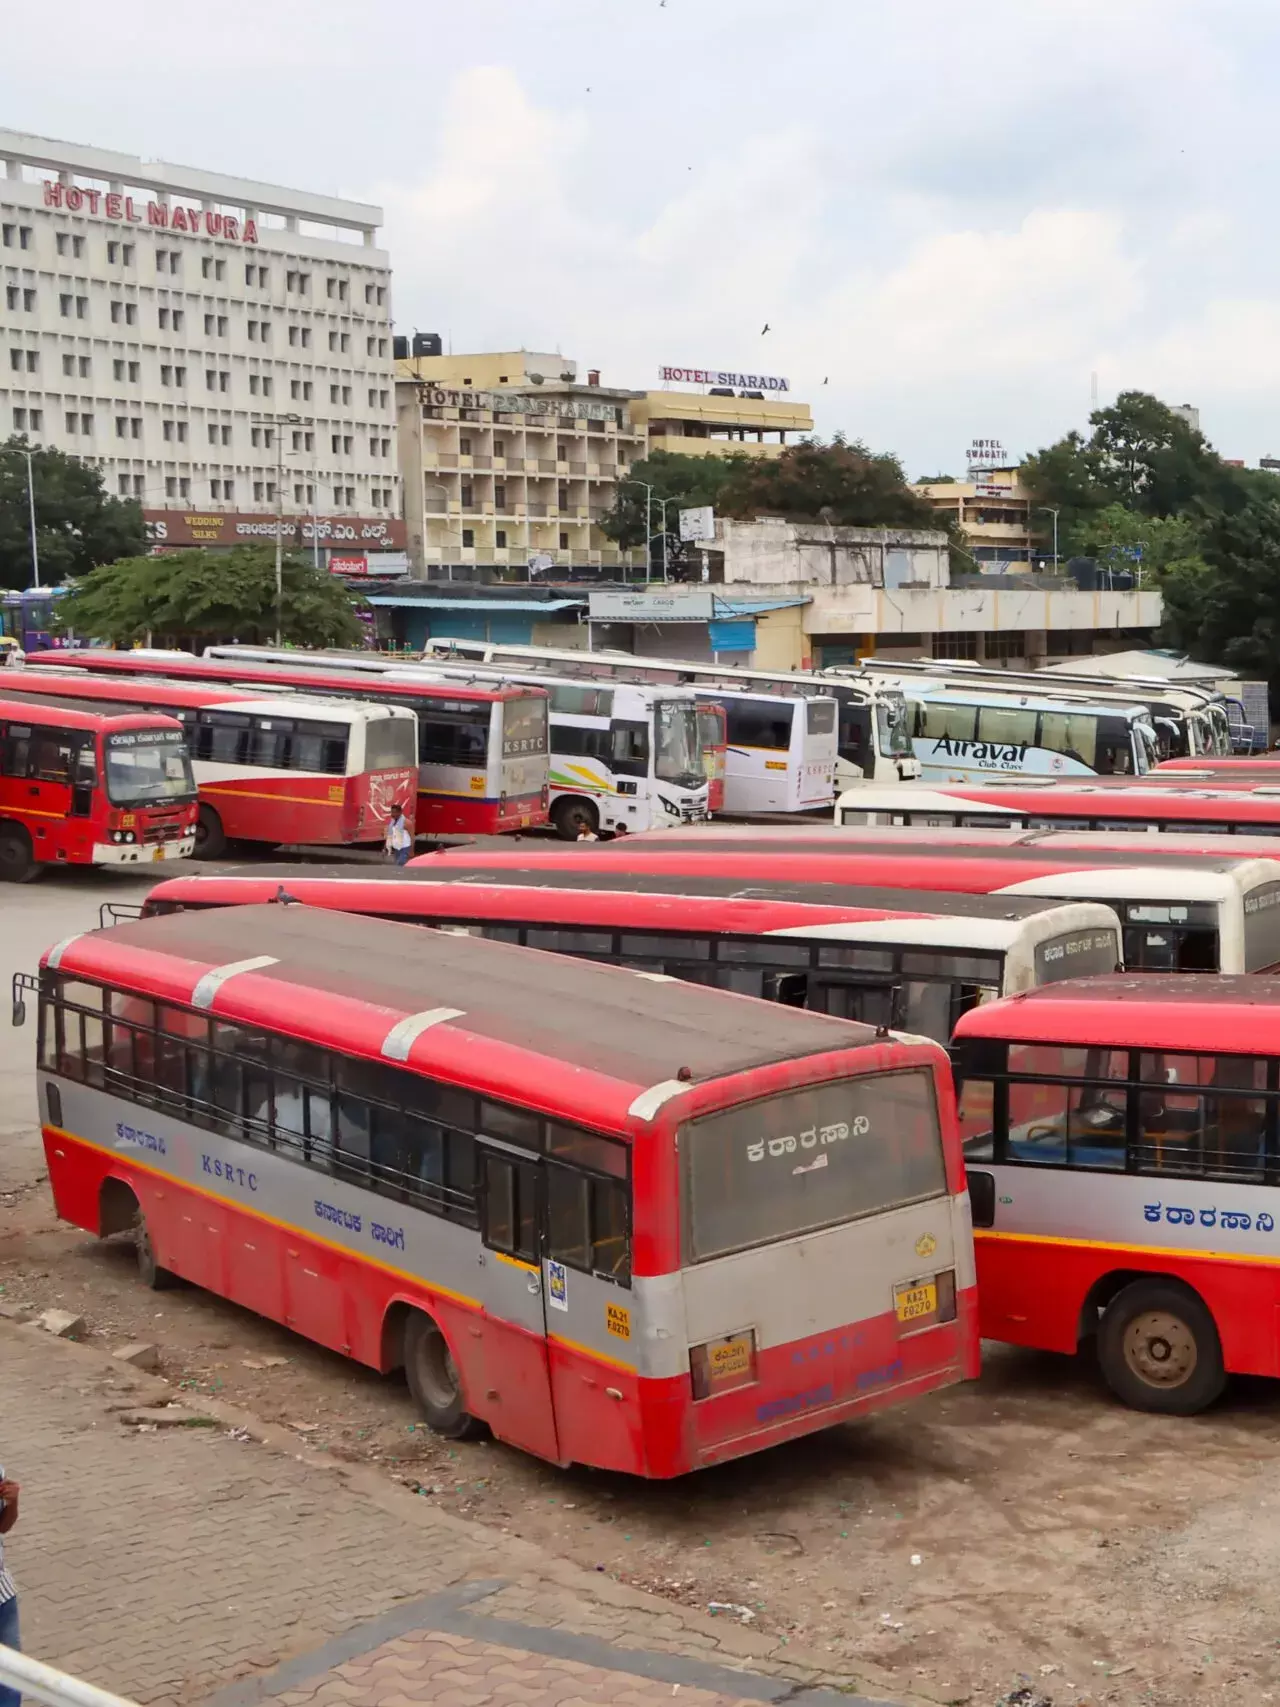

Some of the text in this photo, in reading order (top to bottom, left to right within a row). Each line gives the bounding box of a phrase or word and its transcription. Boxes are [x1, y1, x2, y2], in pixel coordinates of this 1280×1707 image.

[43, 180, 259, 244] HOTEL MAYURA
[663, 367, 788, 391] HOTEL SHARADA
[418, 388, 486, 408] HOTEL
[972, 439, 1002, 448] HOTEL
[966, 450, 1008, 458] SWAGATH
[183, 516, 224, 526] WEDDING
[191, 530, 218, 539] SILKS
[504, 736, 544, 753] KSRTC
[978, 760, 1023, 771] Club Class
[746, 1114, 871, 1163] ಕರಾರಸಾನಿ
[201, 1154, 258, 1191] KSRTC
[314, 1199, 405, 1251] ಕರ್ನಾಟಕ ಸಾರಿಗೆ
[1142, 1200, 1275, 1232] ಕರಾರಸಾನಿ
